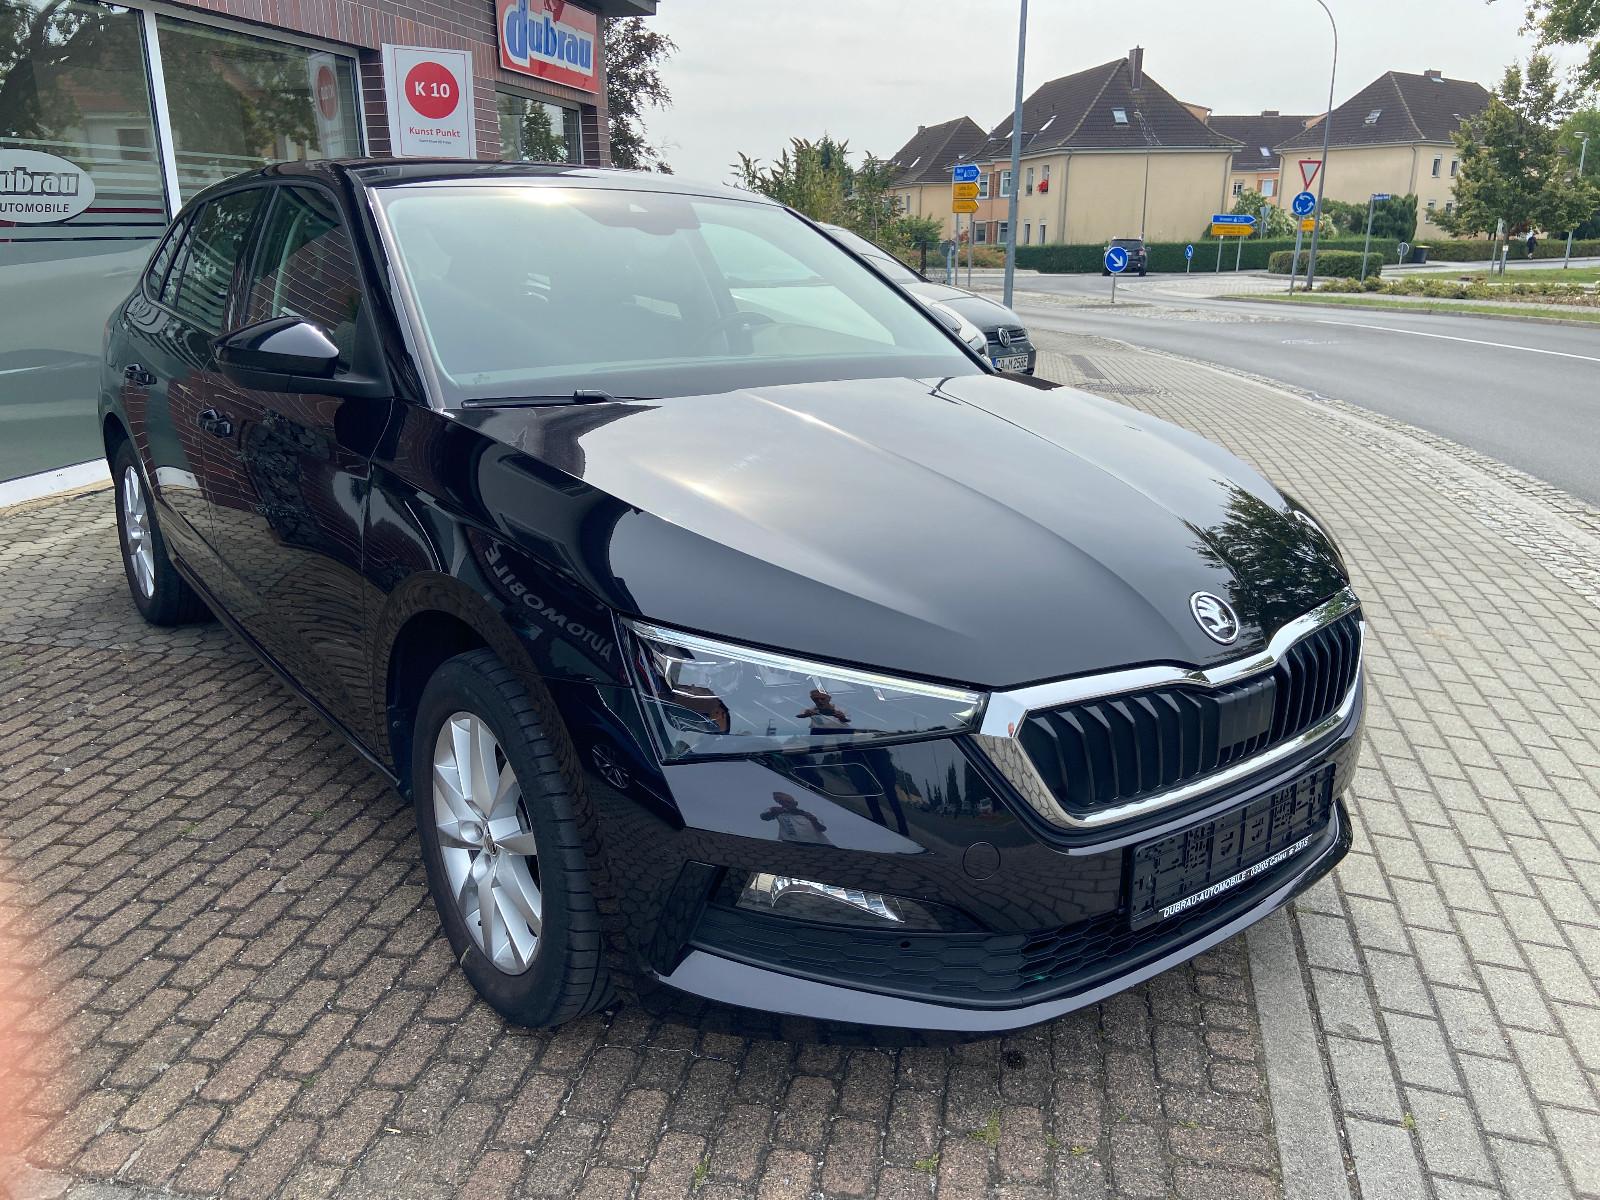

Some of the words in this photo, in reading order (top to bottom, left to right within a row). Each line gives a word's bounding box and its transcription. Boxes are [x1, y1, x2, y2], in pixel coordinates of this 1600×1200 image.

[505, 0, 592, 71] dubrau
[414, 81, 426, 97] K
[430, 83, 450, 98] 10
[409, 126, 434, 136] Kunst
[435, 128, 461, 138] Punkt
[1163, 871, 1246, 918] DUBRAU-AUTOMOBILE
